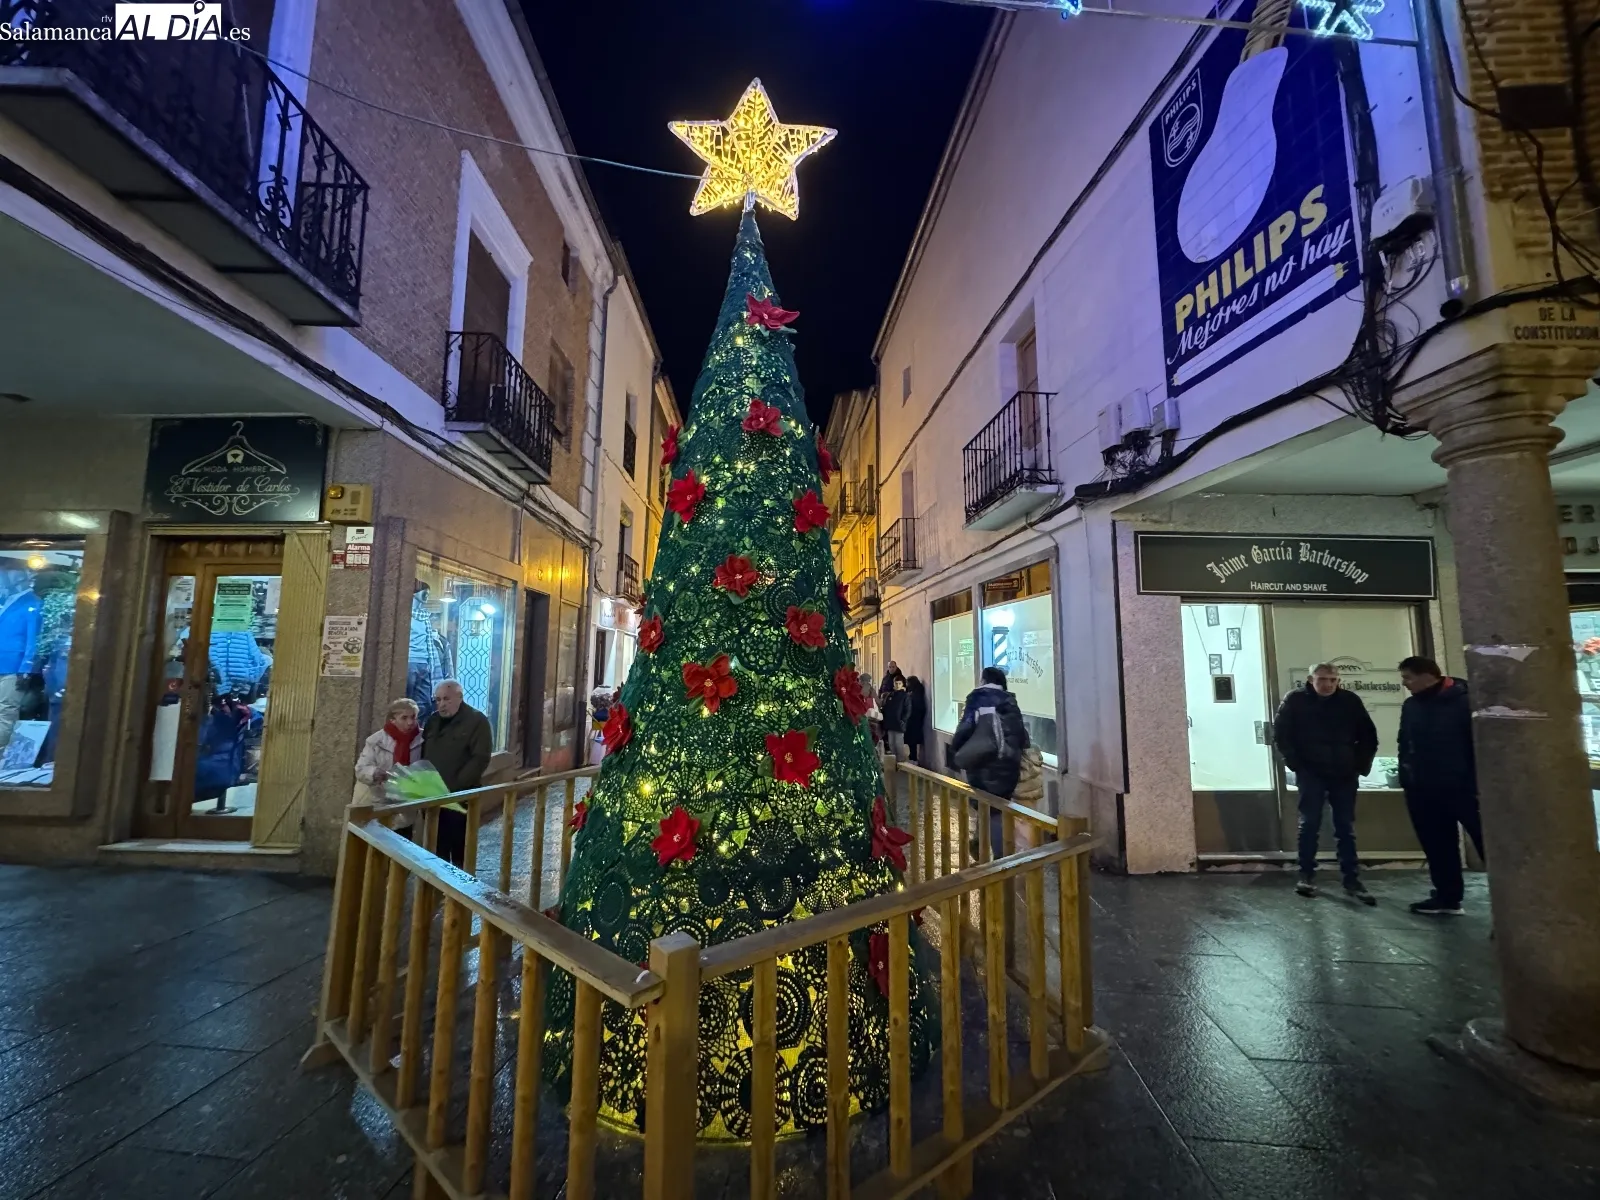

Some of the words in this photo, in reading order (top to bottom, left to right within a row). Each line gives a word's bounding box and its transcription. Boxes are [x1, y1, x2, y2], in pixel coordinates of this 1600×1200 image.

[1165, 78, 1197, 125] PHILIPS
[1174, 183, 1328, 335] PHILIPS
[1167, 282, 1260, 365] Mejores
[1263, 255, 1297, 297] no
[1301, 218, 1351, 272] hay
[1538, 306, 1556, 322] DE
[1561, 306, 1577, 322] LA
[202, 465, 228, 473] MODA
[232, 465, 268, 473] HOMBRE
[169, 474, 187, 493] El
[187, 475, 232, 493] Vestidor
[236, 476, 252, 493] de
[253, 474, 292, 493] Carlos
[347, 543, 371, 551] Alarma
[1205, 554, 1249, 584] Jaime
[1251, 540, 1293, 565] García
[1298, 542, 1370, 585] Barbershop
[1285, 583, 1302, 592] AND
[1302, 583, 1329, 592] SHAVE
